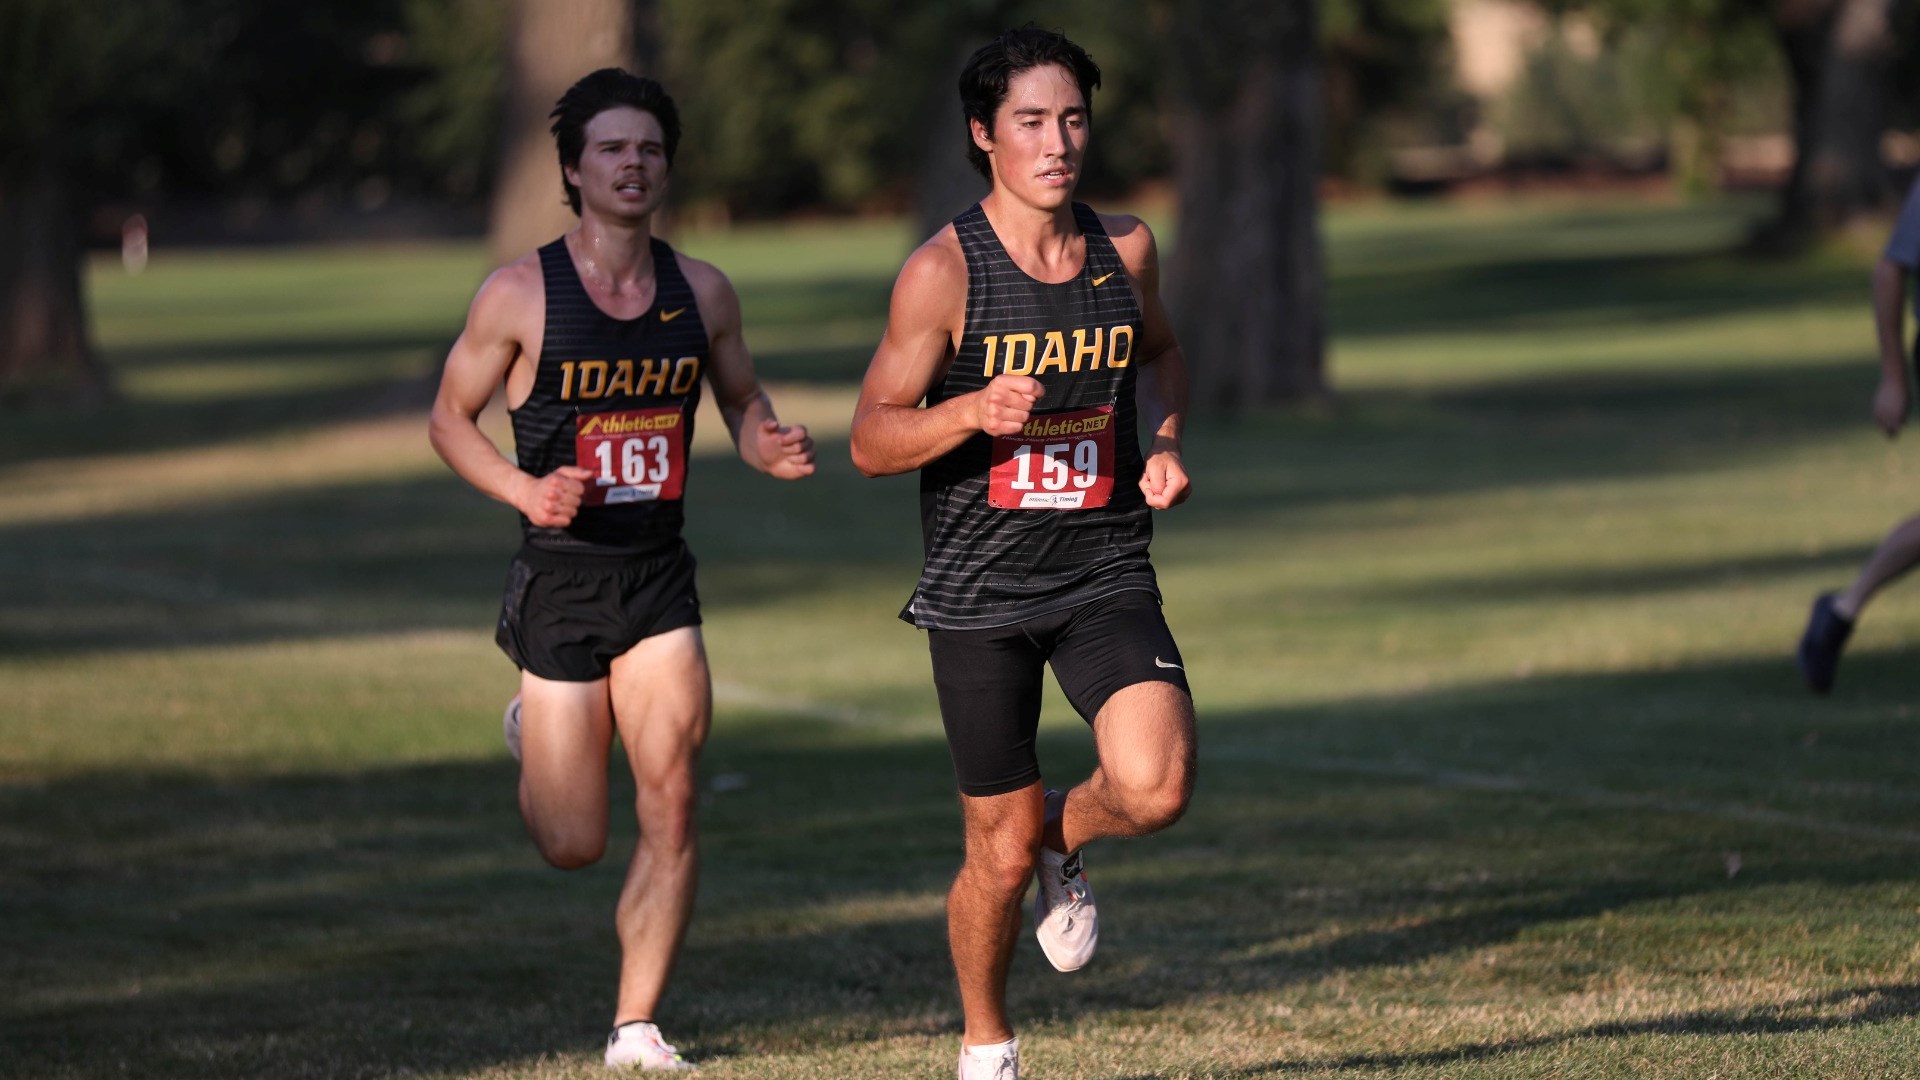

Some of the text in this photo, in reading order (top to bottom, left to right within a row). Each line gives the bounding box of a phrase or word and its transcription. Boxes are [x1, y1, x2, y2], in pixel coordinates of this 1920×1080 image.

[983, 325, 1134, 377] IDAHO
[560, 357, 699, 400] IDAHO
[579, 414, 654, 435] Athletic
[1023, 417, 1084, 437] thletic
[1085, 418, 1107, 431] NET
[595, 435, 670, 486] 163
[1010, 440, 1098, 491] 159
